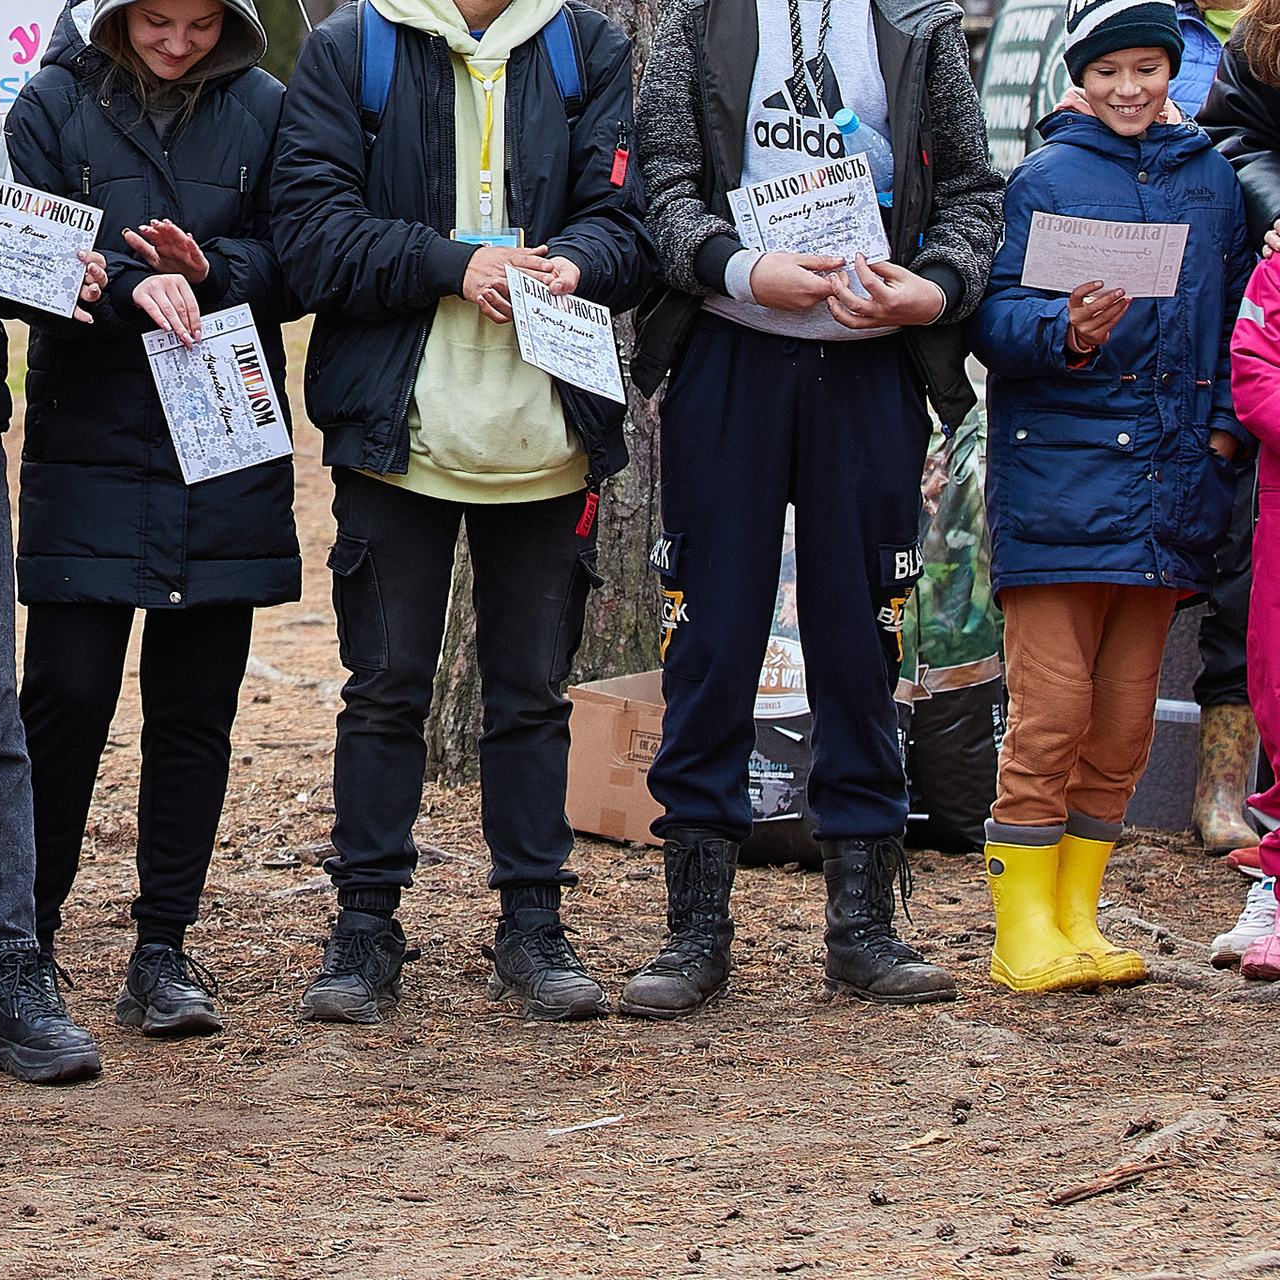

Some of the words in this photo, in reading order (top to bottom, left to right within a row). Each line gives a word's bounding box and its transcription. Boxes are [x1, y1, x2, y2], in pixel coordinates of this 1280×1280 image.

[754, 116, 847, 159] adida
[753, 157, 867, 207] БЛАГОДАРНОСТЬ
[523, 276, 608, 327] БЛАГОДАРНОСТЬ
[230, 341, 277, 428] ДИПЛОМ
